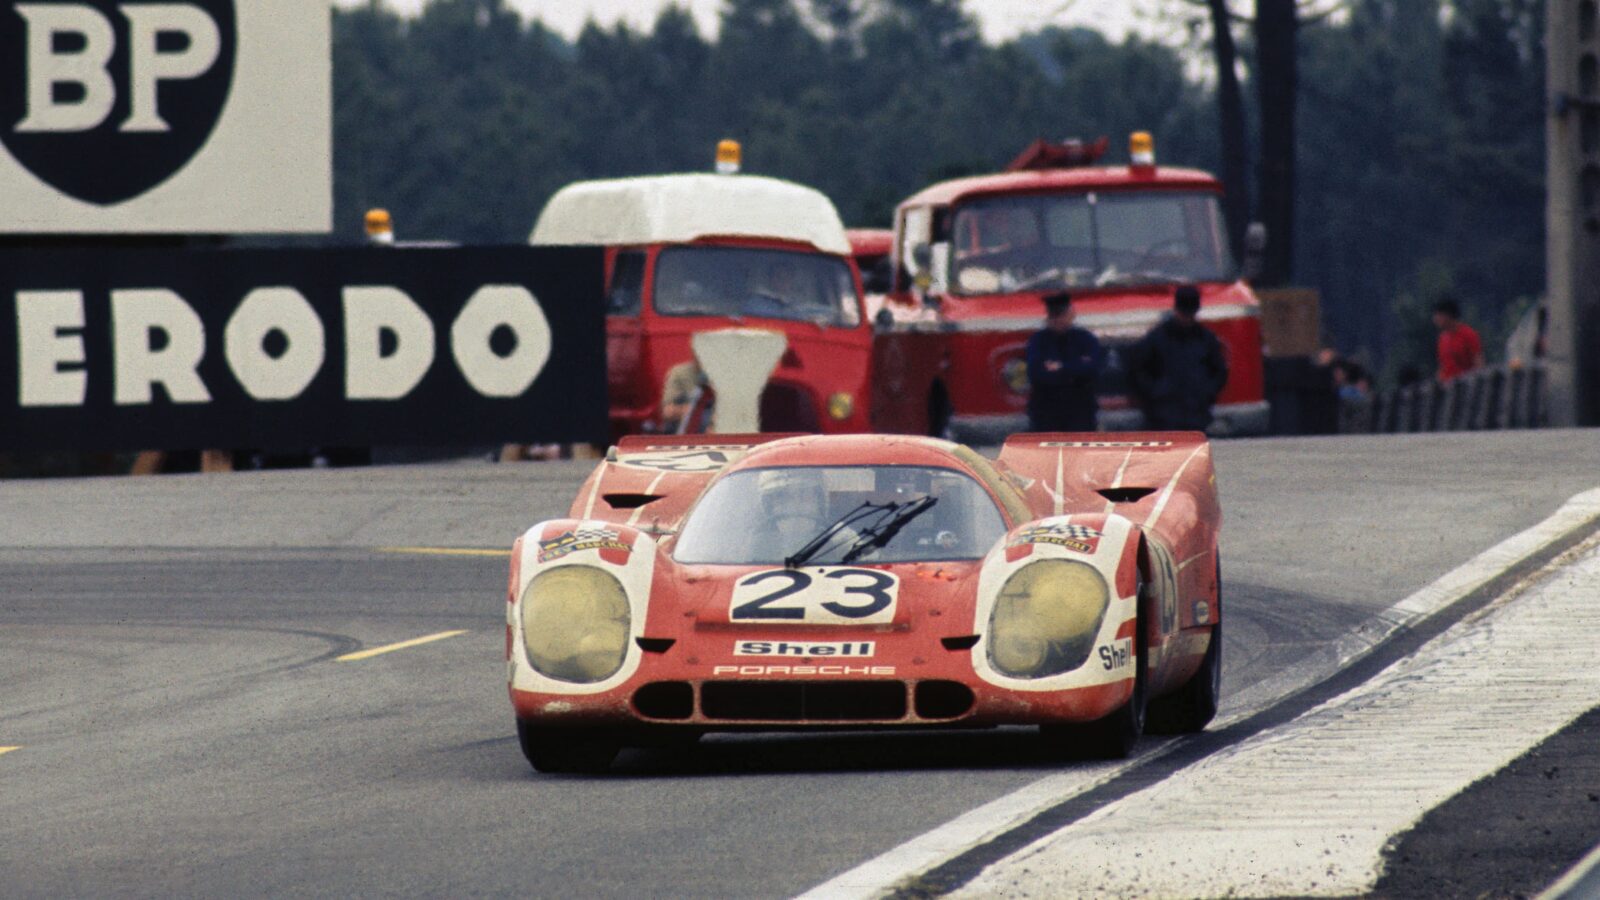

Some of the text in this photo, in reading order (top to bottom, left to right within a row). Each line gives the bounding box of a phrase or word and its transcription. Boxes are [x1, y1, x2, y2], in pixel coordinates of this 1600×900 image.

[13, 3, 221, 132] BP
[15, 284, 552, 405] ERODO
[731, 568, 896, 620] 23
[740, 642, 870, 656] Shell
[1098, 640, 1132, 671] Shell
[712, 665, 897, 676] PORSCHE
